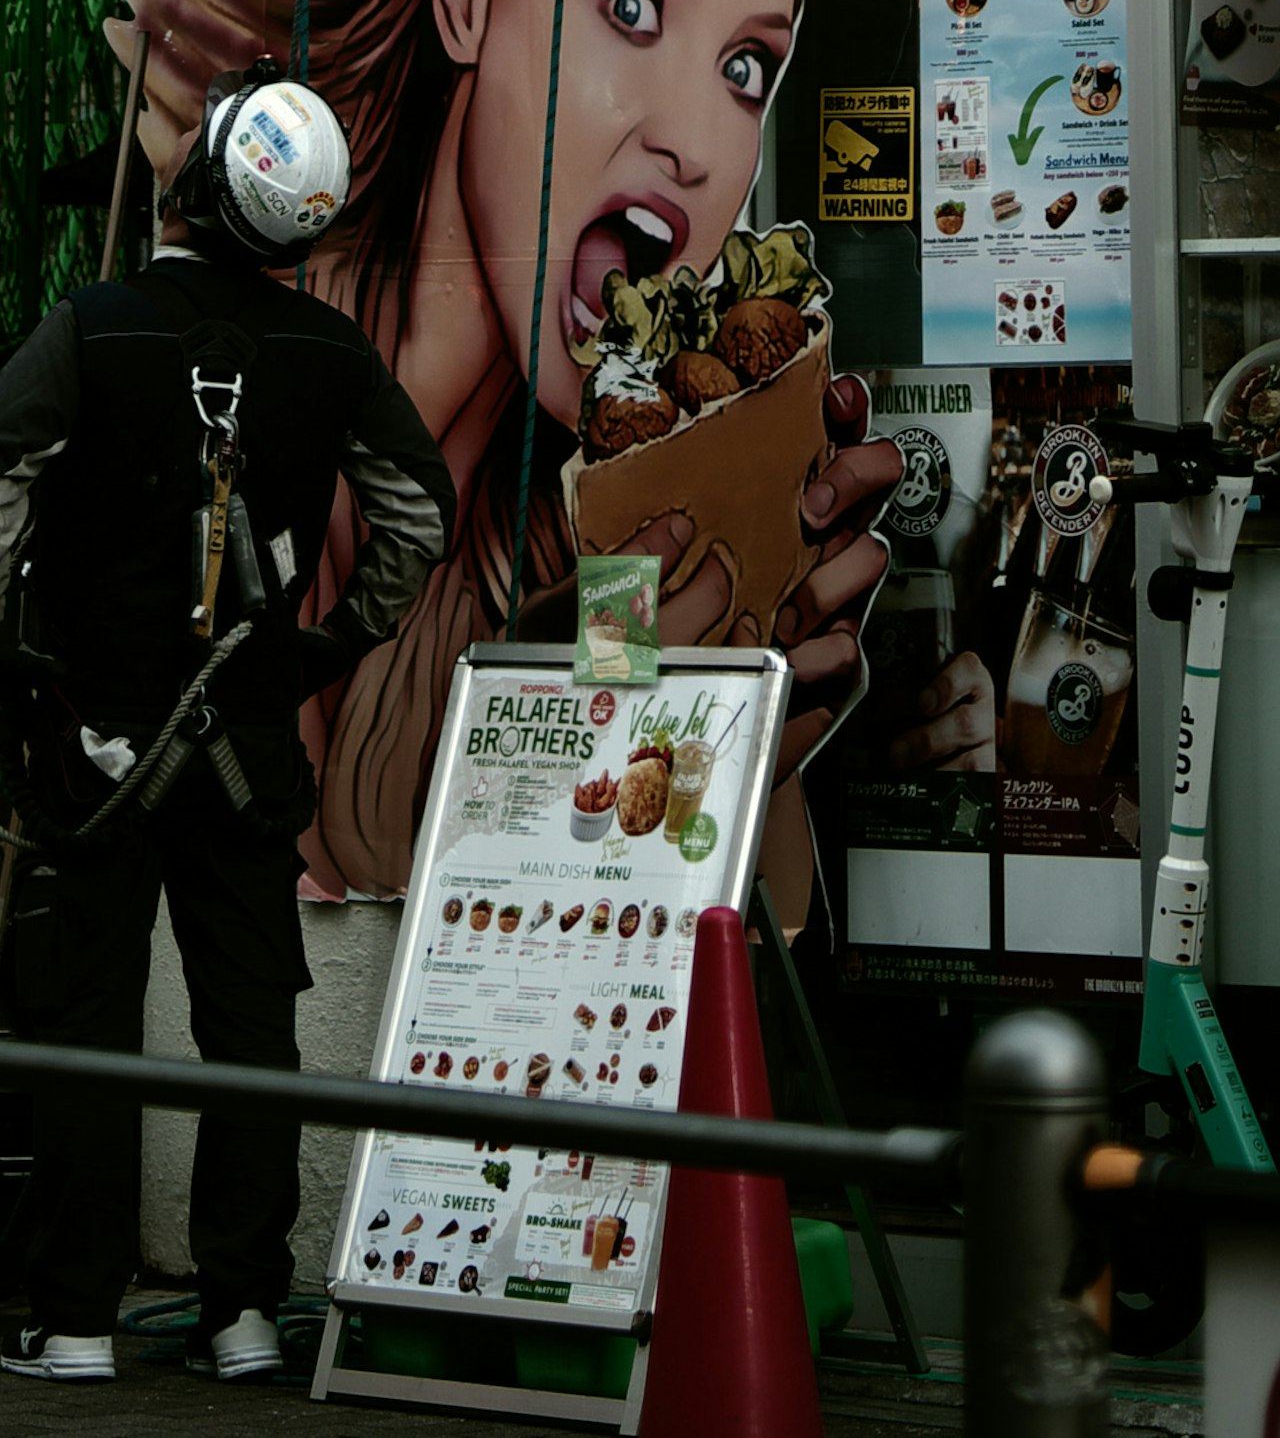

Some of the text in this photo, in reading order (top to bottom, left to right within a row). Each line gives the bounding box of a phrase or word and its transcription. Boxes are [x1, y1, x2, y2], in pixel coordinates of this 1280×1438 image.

[1045, 152, 1130, 169] Sandwich Menu
[267, 191, 290, 217] SCN
[824, 198, 908, 217] WARNING
[930, 383, 973, 414] LAGER
[1040, 427, 1103, 461] BROOKLYN
[891, 512, 941, 536] LAGER
[582, 571, 641, 606] SANDWICH
[485, 696, 585, 727] FALAFEL
[592, 709, 609, 721] OK
[471, 757, 581, 771] FRESH FALAFEL VEGAN SHOP
[463, 799, 484, 811] HOW
[461, 811, 489, 822] ORDER
[683, 838, 711, 848] MENU
[519, 860, 633, 881] MAIN DISH MENU
[590, 982, 666, 1000] LIGHT MEAL
[391, 1187, 496, 1214] VEGAN SWEETS
[525, 1214, 583, 1231] BRO-SHAKE
[508, 1280, 534, 1293] SPECIAL
